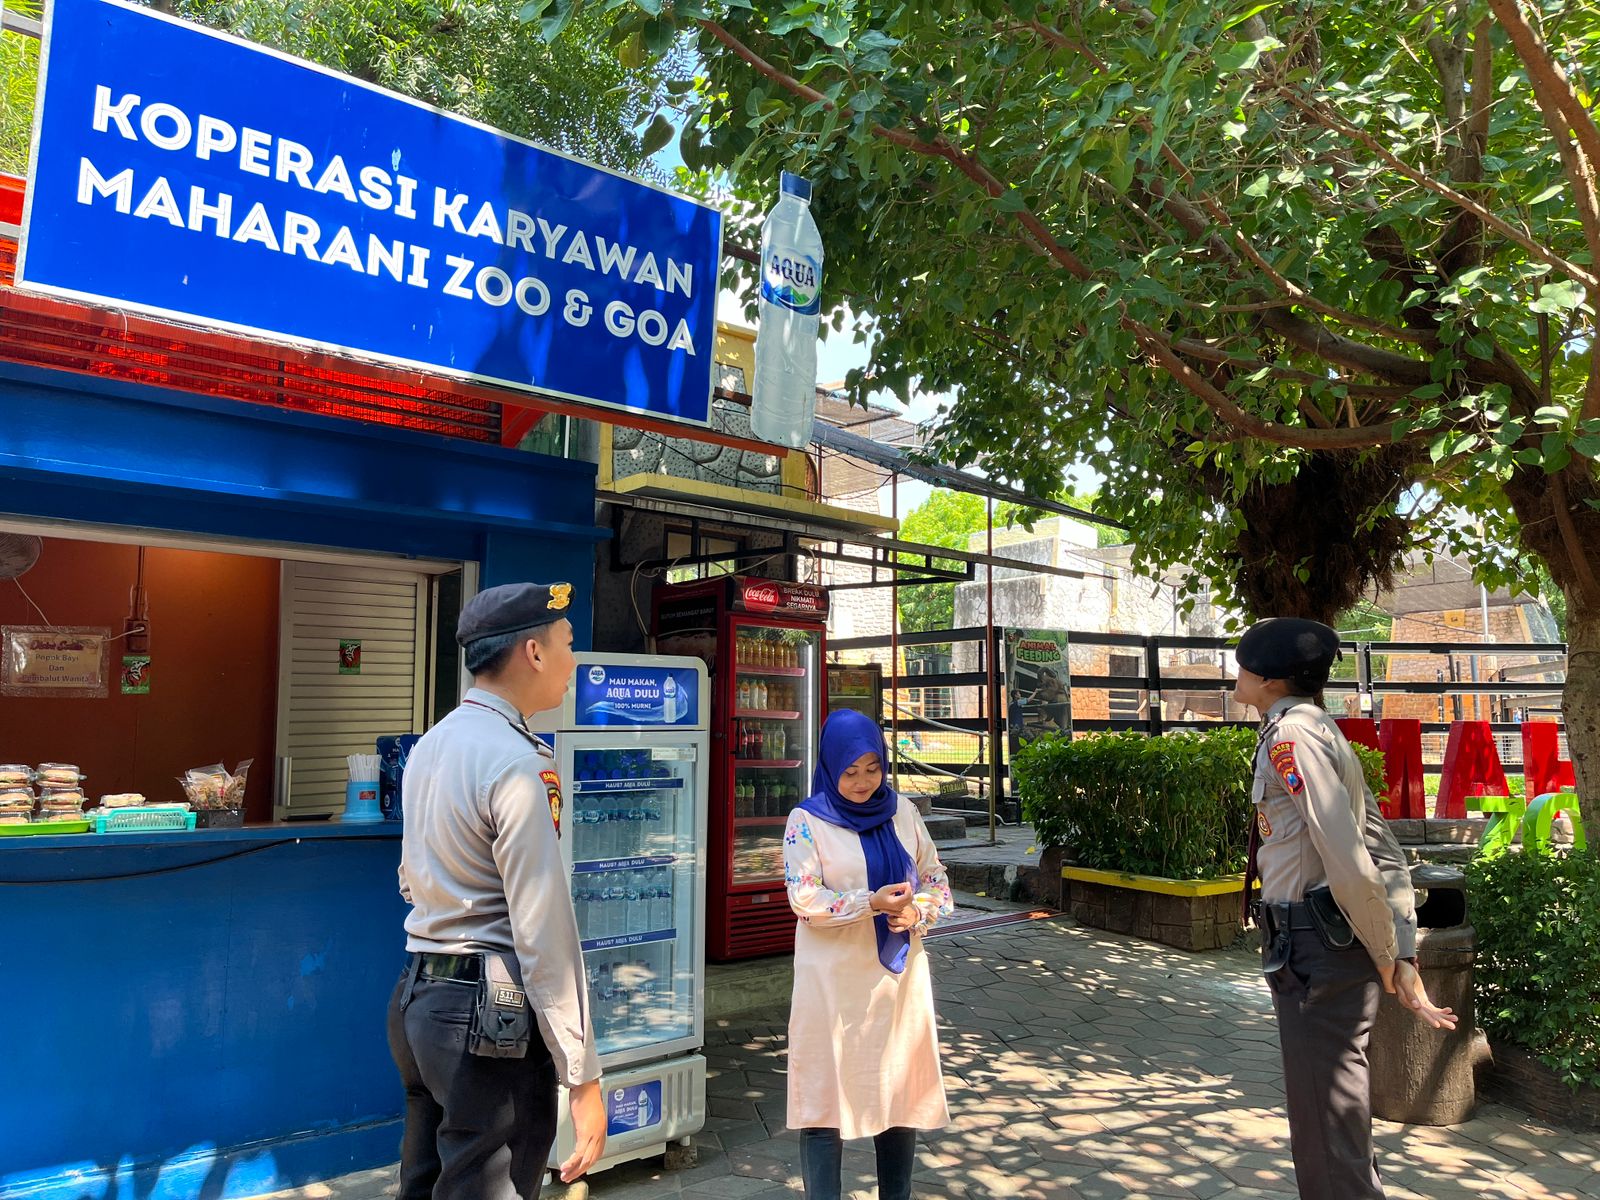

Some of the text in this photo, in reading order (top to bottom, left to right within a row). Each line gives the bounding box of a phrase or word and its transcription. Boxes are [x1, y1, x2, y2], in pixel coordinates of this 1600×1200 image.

[92, 84, 693, 299] KOPERASI KARYAWAN
[76, 156, 696, 356] MAHARANI ZOO & GOA
[770, 254, 815, 288] AQUA
[783, 587, 803, 596] BREAK
[790, 595, 815, 604] NIKMATI
[786, 601, 817, 611] SEGARNYA
[1020, 640, 1057, 651] ANIMAL
[1016, 648, 1061, 662] FEEDING
[609, 678, 627, 686] MAU
[606, 687, 660, 700] AQUA DULU
[629, 935, 643, 943] DULU
